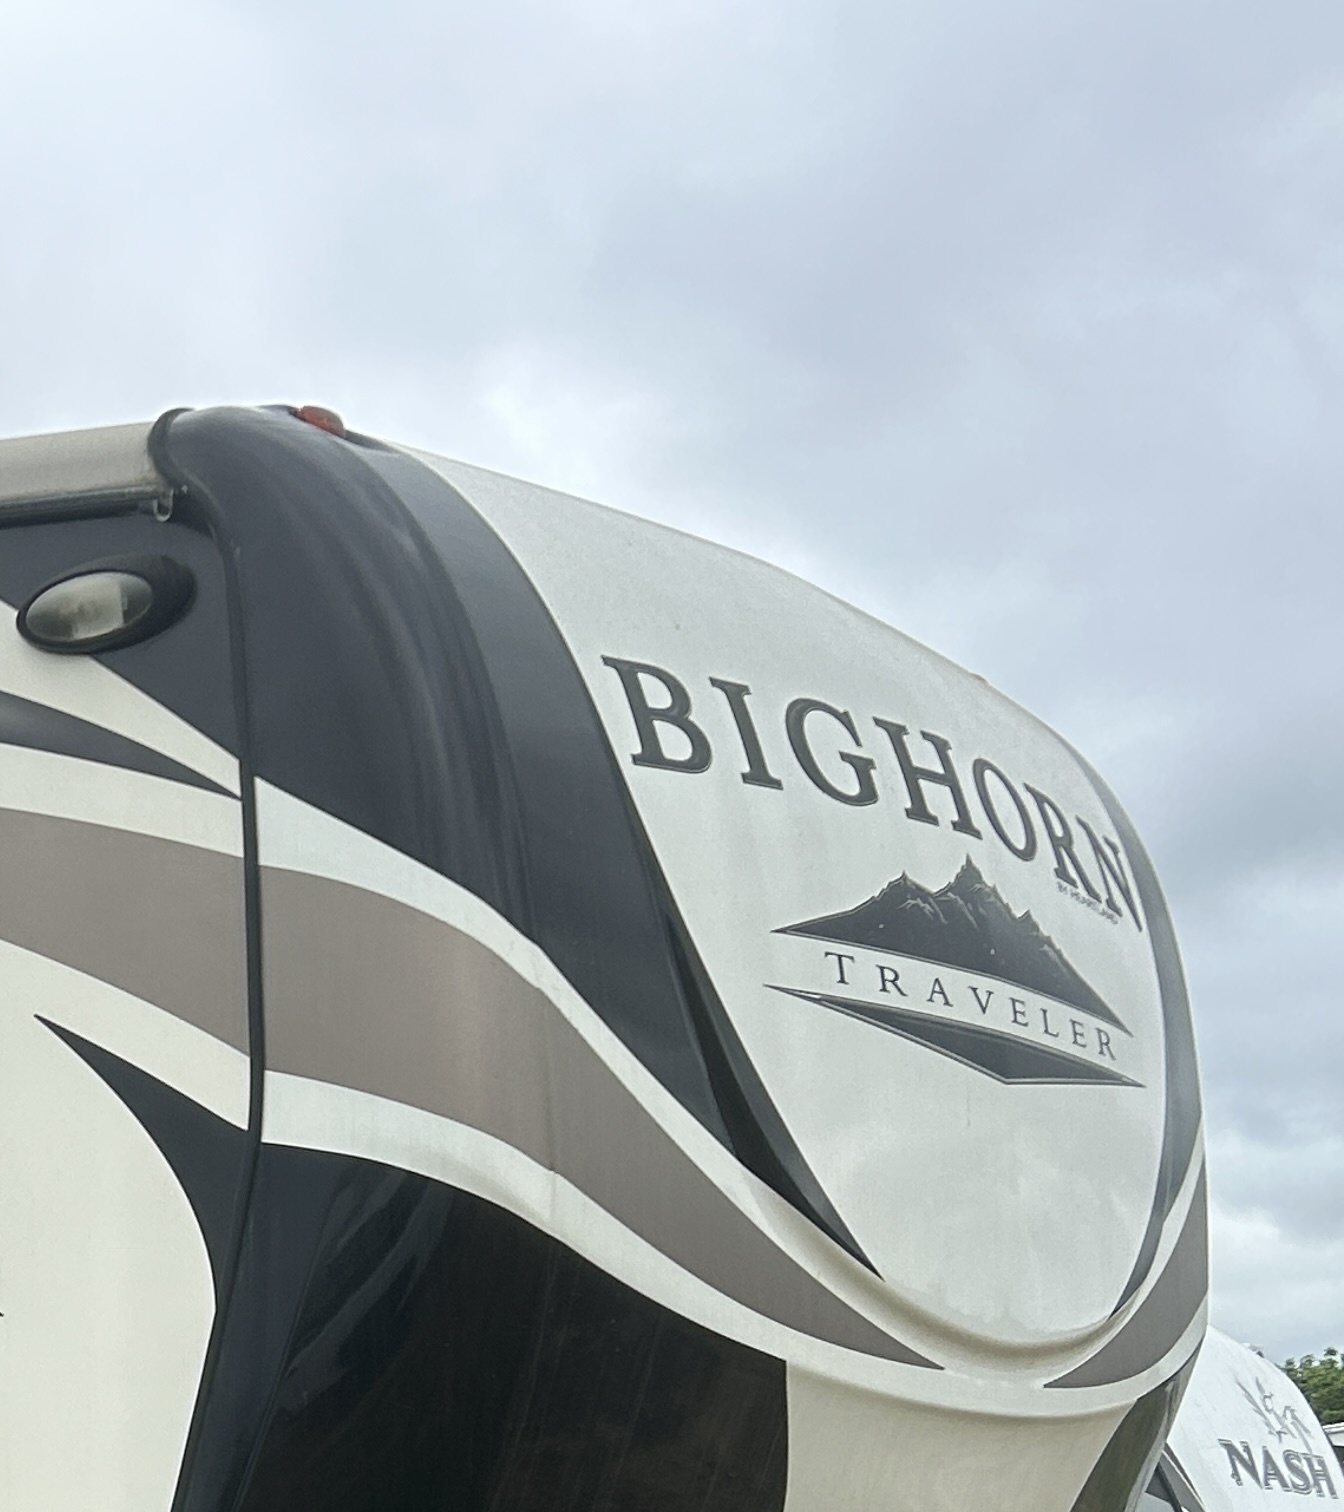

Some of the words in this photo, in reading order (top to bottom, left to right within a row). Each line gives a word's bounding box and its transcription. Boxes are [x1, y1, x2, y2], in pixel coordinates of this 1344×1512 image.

[602, 655, 1143, 932] BIGHORN
[824, 950, 1118, 1062] TRAVELER
[1217, 1438, 1339, 1499] NASH
